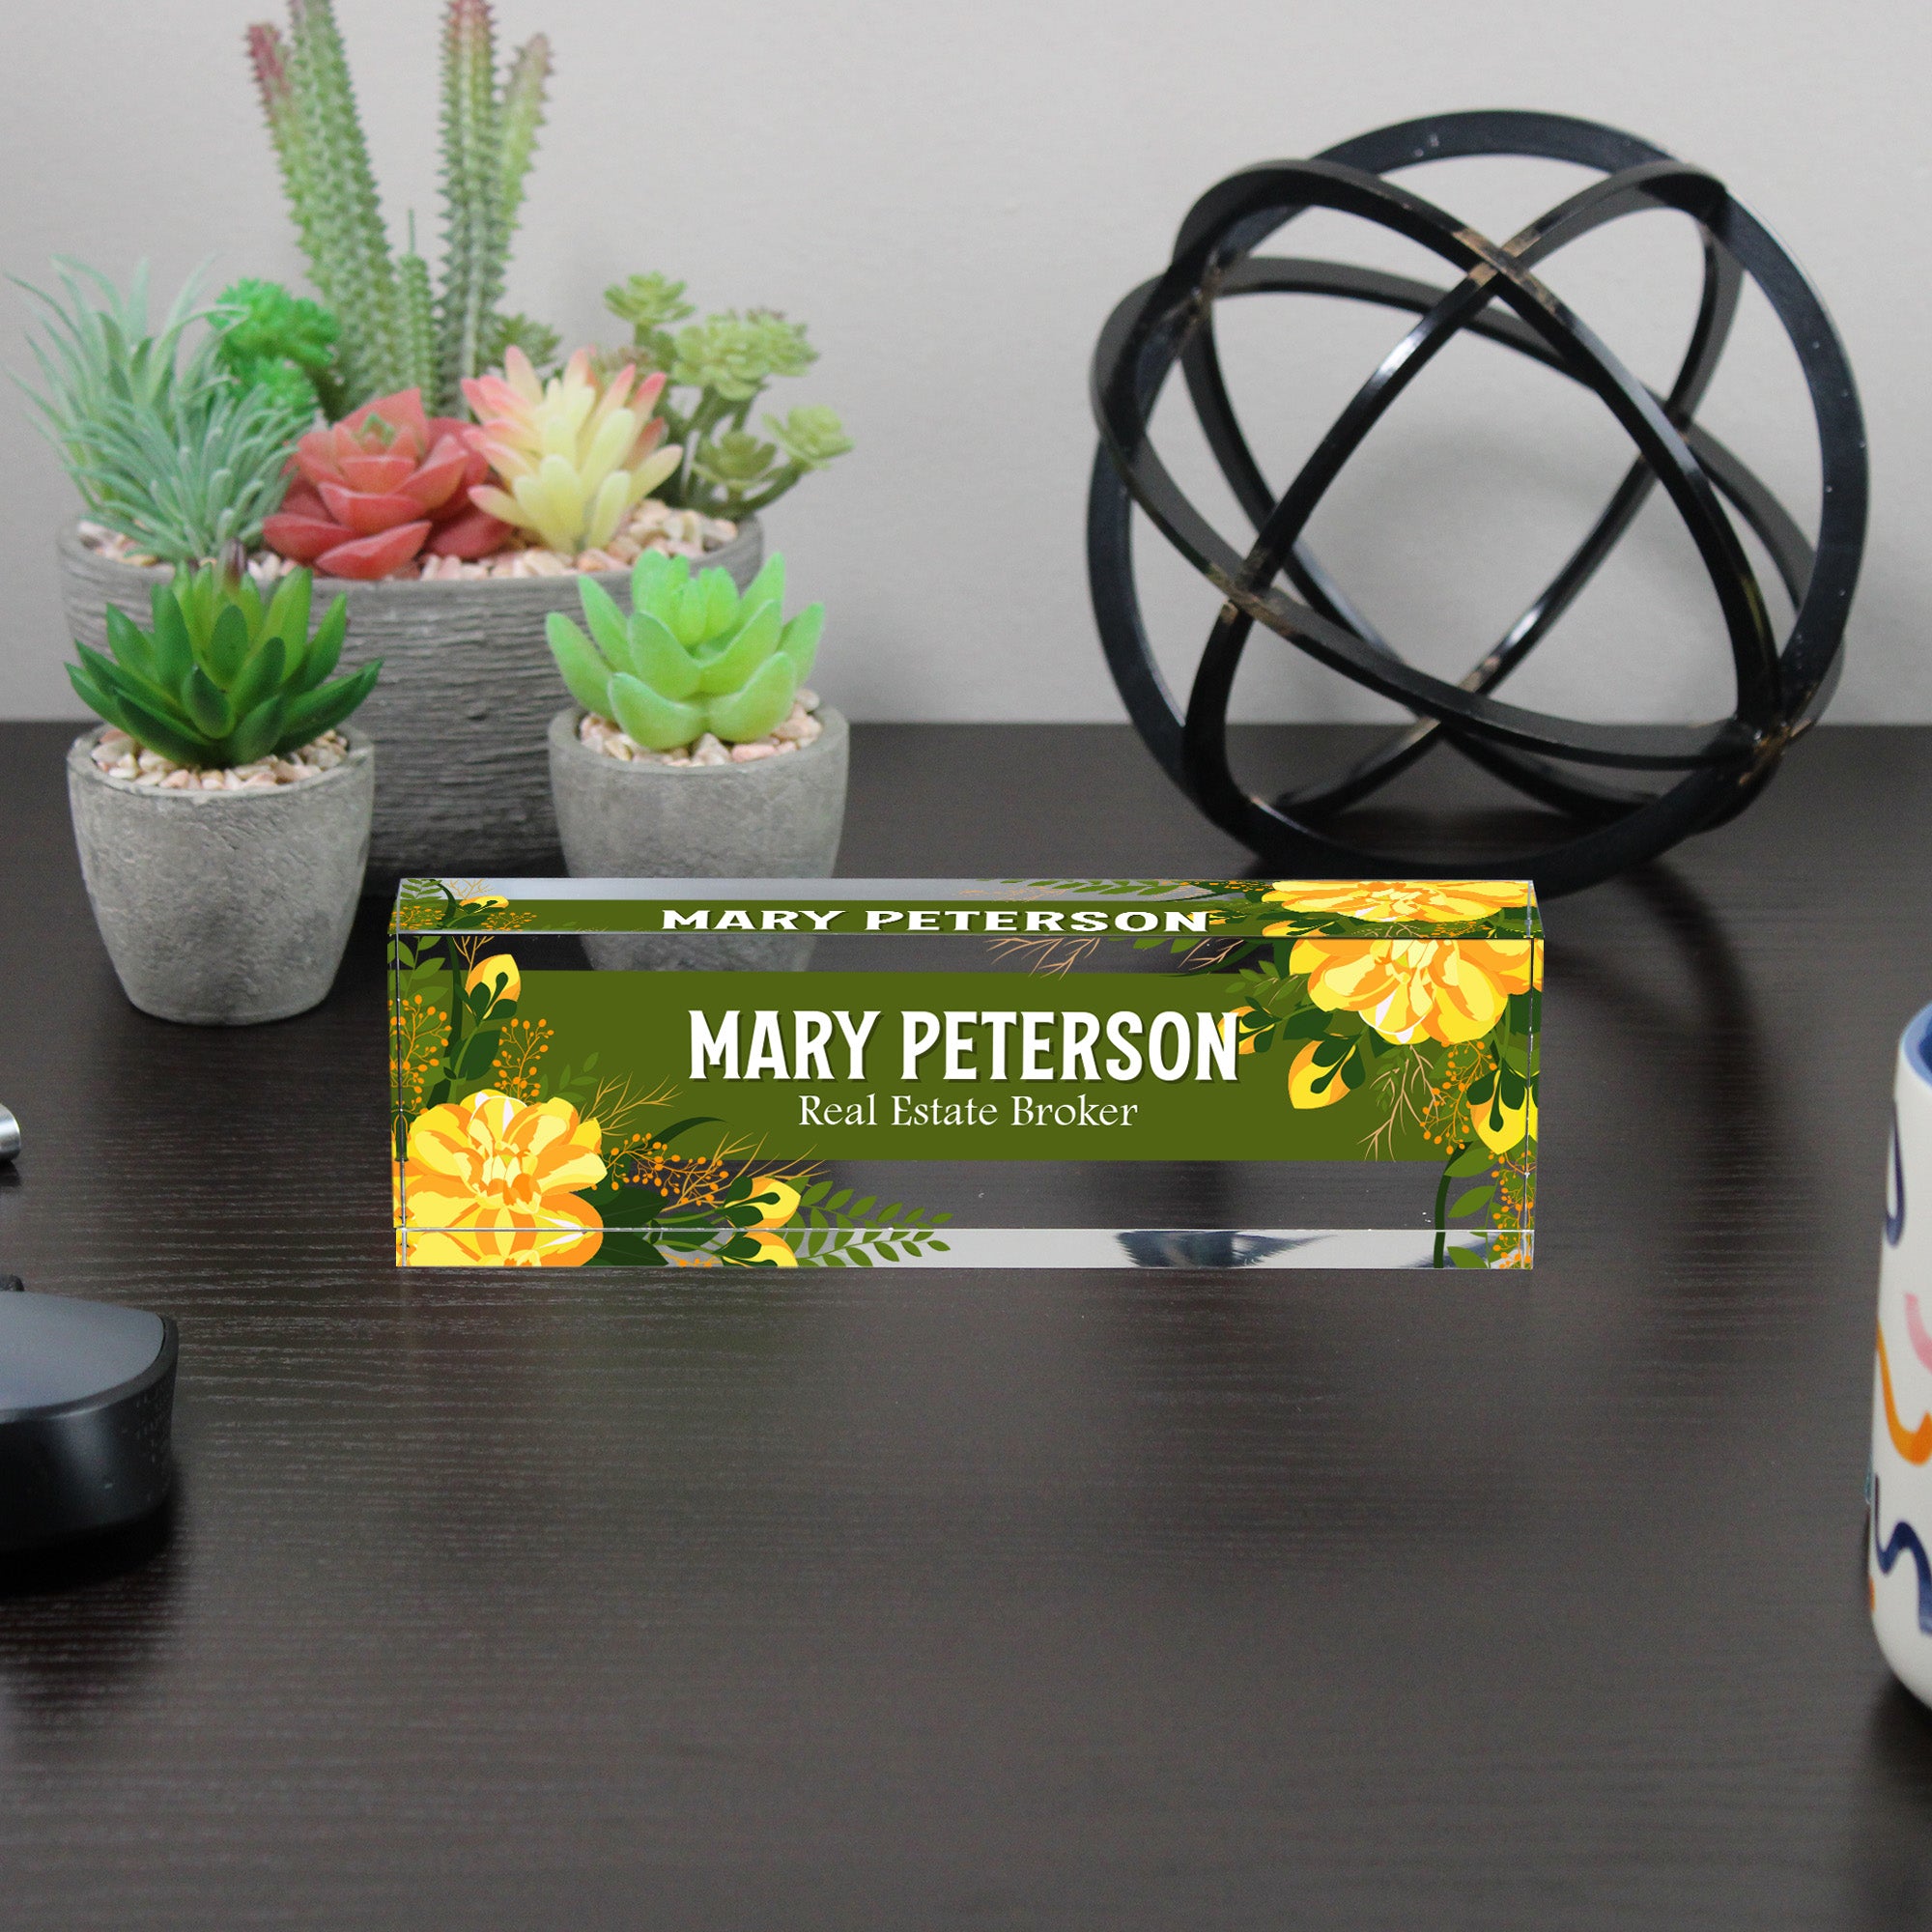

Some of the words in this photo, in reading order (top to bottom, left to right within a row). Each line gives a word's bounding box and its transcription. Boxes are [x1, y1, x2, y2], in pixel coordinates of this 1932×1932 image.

[662, 909, 846, 931] MARY
[865, 909, 1210, 933] PETERSON
[688, 1009, 881, 1080] MARY
[900, 1010, 1239, 1081] PETERSON
[798, 1093, 878, 1125] Real
[891, 1094, 998, 1126] Estate
[1010, 1094, 1138, 1126] Broker
